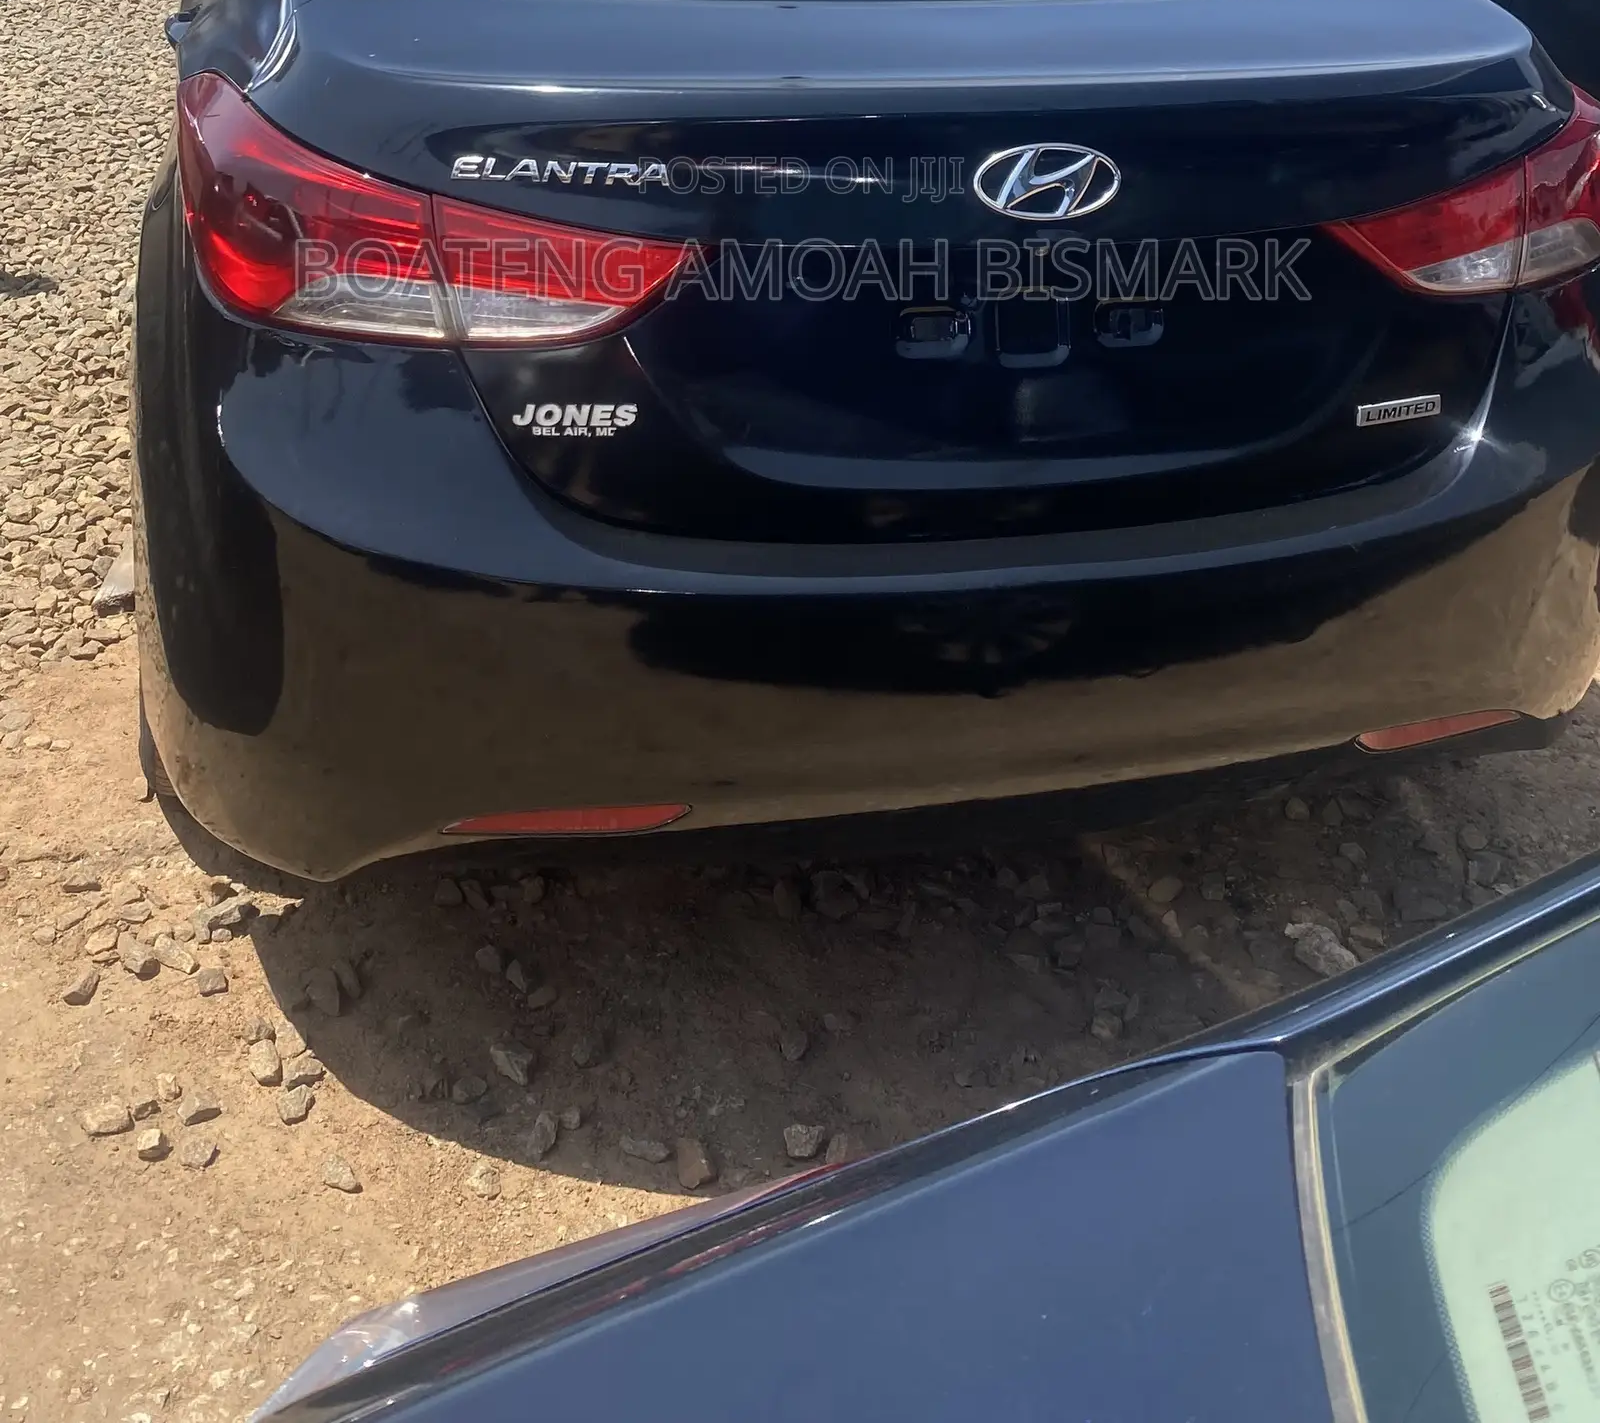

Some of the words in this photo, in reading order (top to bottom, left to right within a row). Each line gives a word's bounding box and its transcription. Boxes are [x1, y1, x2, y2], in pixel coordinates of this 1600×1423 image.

[450, 156, 670, 186] ELANTRA
[512, 403, 638, 427] JONES
[1366, 401, 1436, 422] LIMITED
[532, 426, 560, 437] BEL
[564, 426, 592, 437] AIR,
